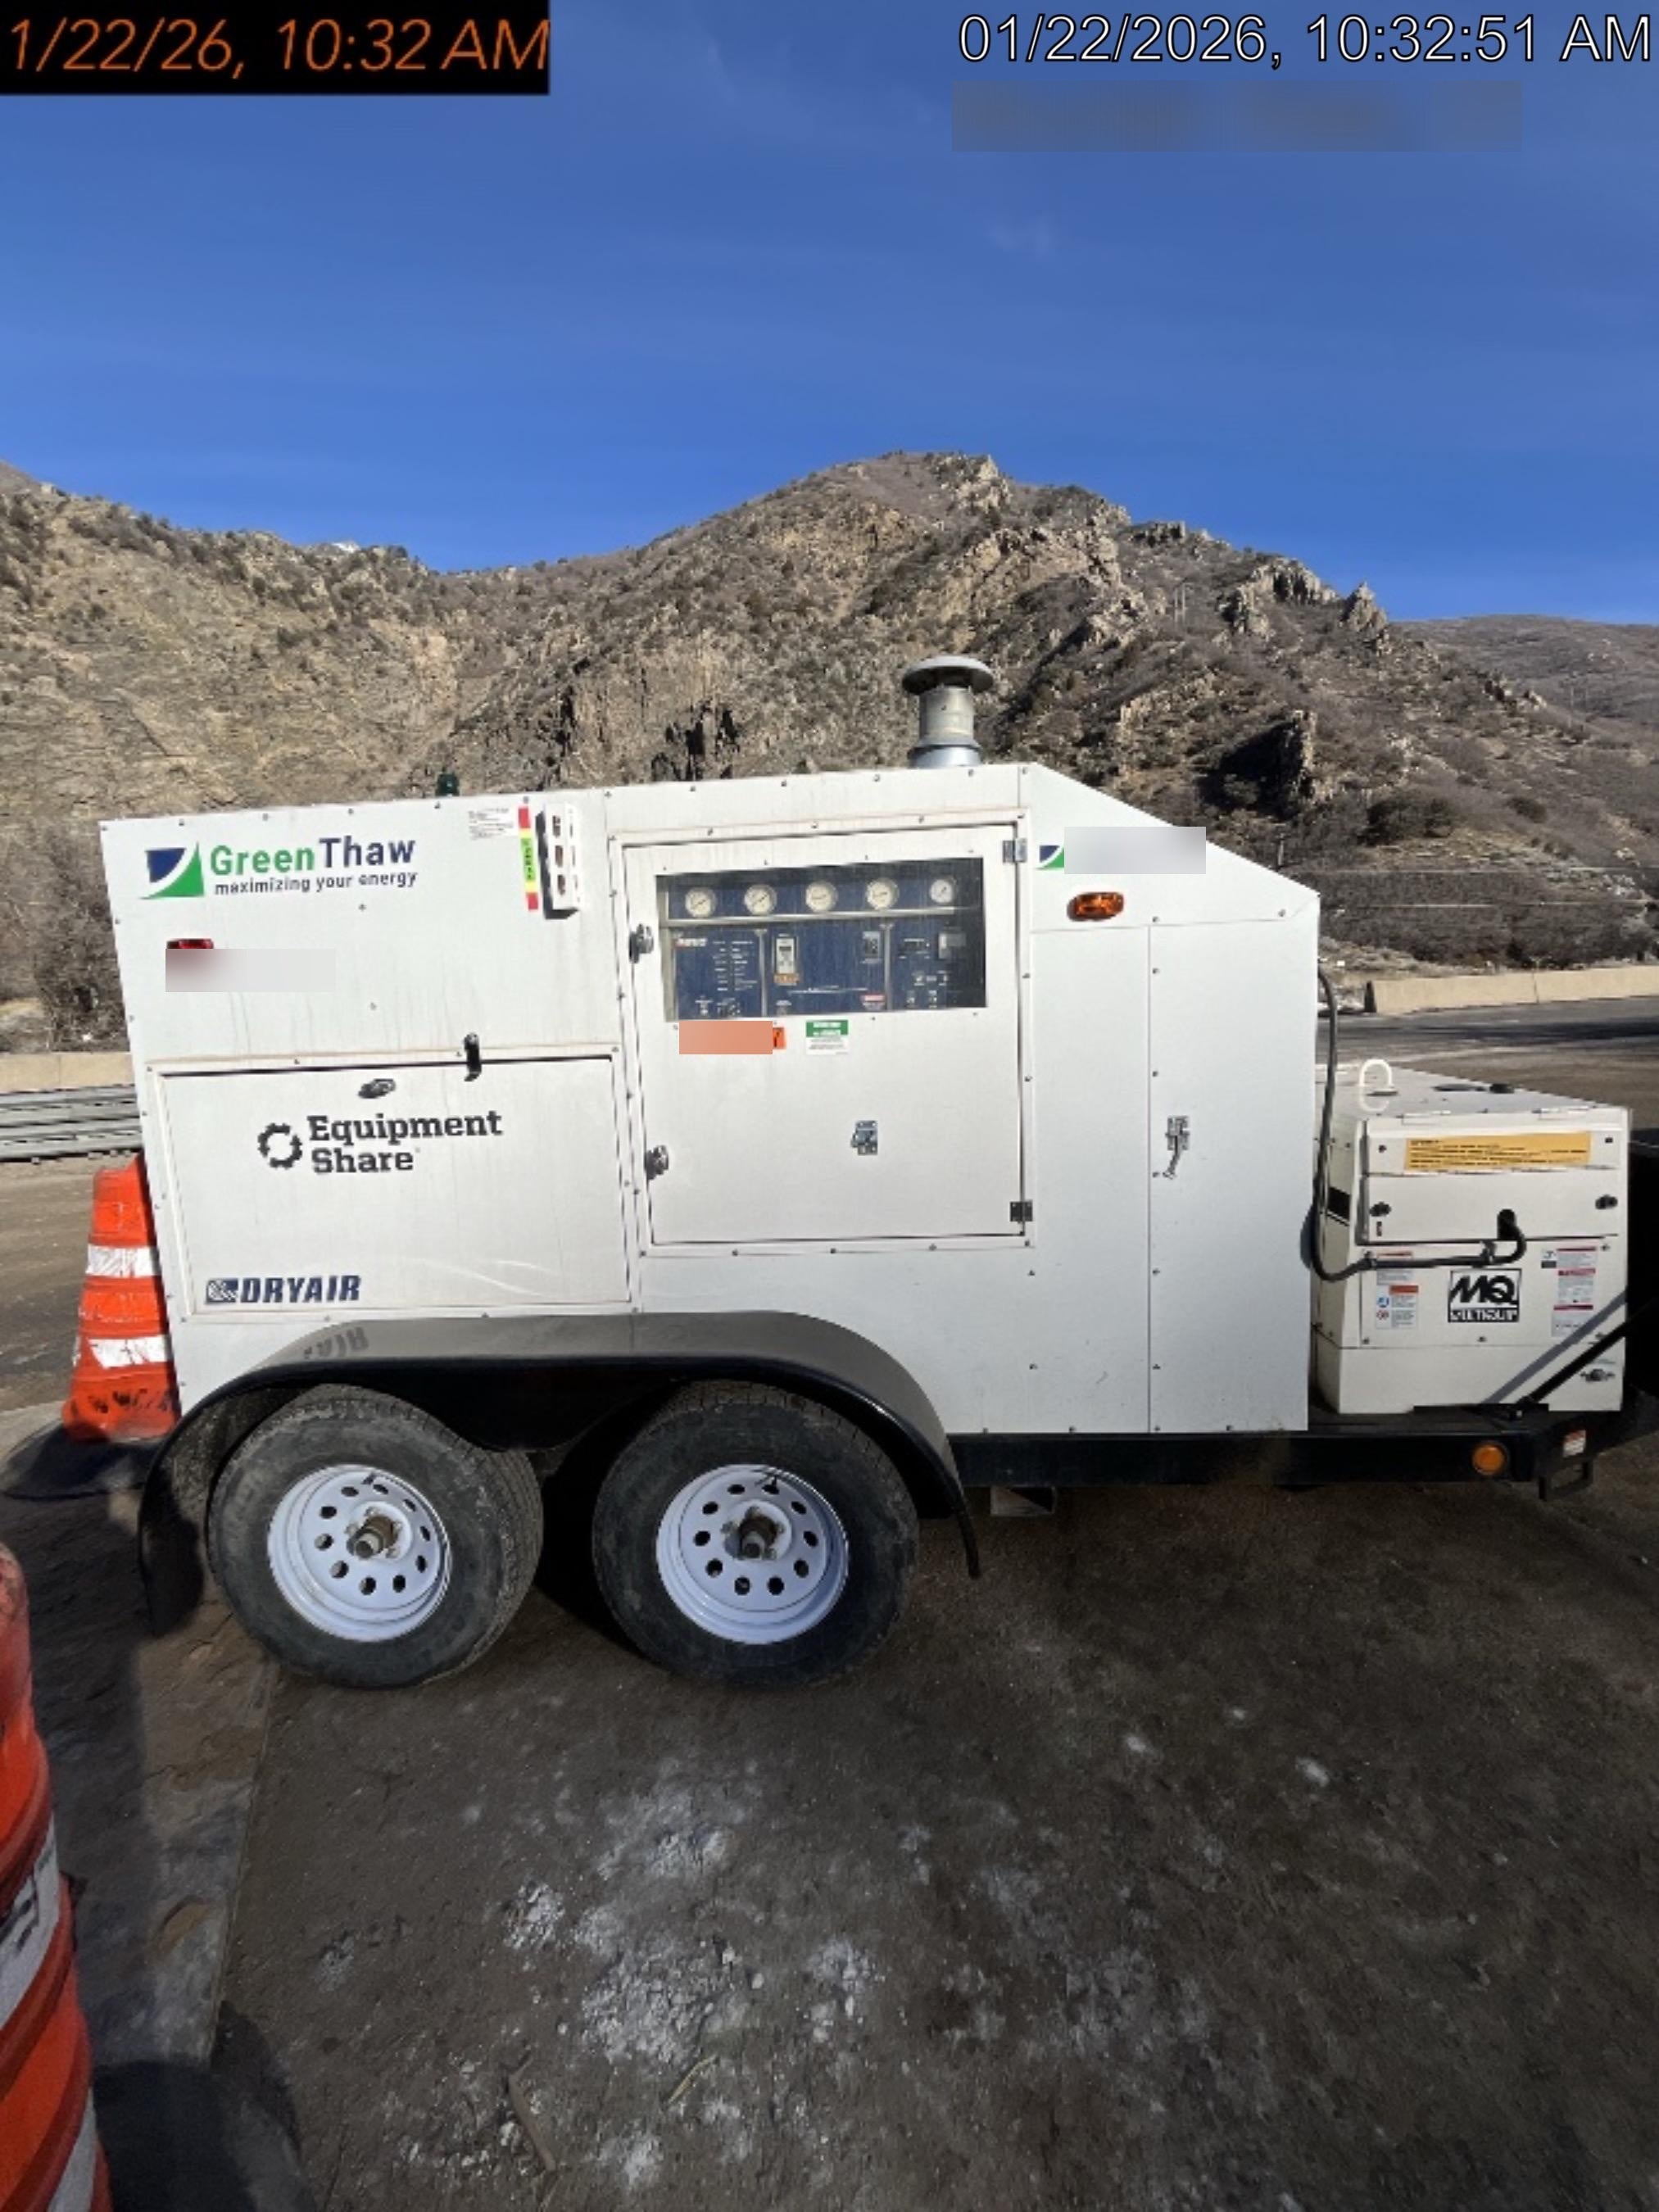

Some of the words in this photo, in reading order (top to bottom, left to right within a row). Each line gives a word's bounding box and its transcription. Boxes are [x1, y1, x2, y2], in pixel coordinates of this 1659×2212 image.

[215, 877, 310, 895] maximizing
[316, 876, 351, 892] your
[358, 872, 417, 887] energy
[307, 1111, 502, 1146] Equipment
[311, 1148, 414, 1173] Share
[240, 1275, 361, 1303] DRYAIR
[1448, 1274, 1518, 1304] MQ
